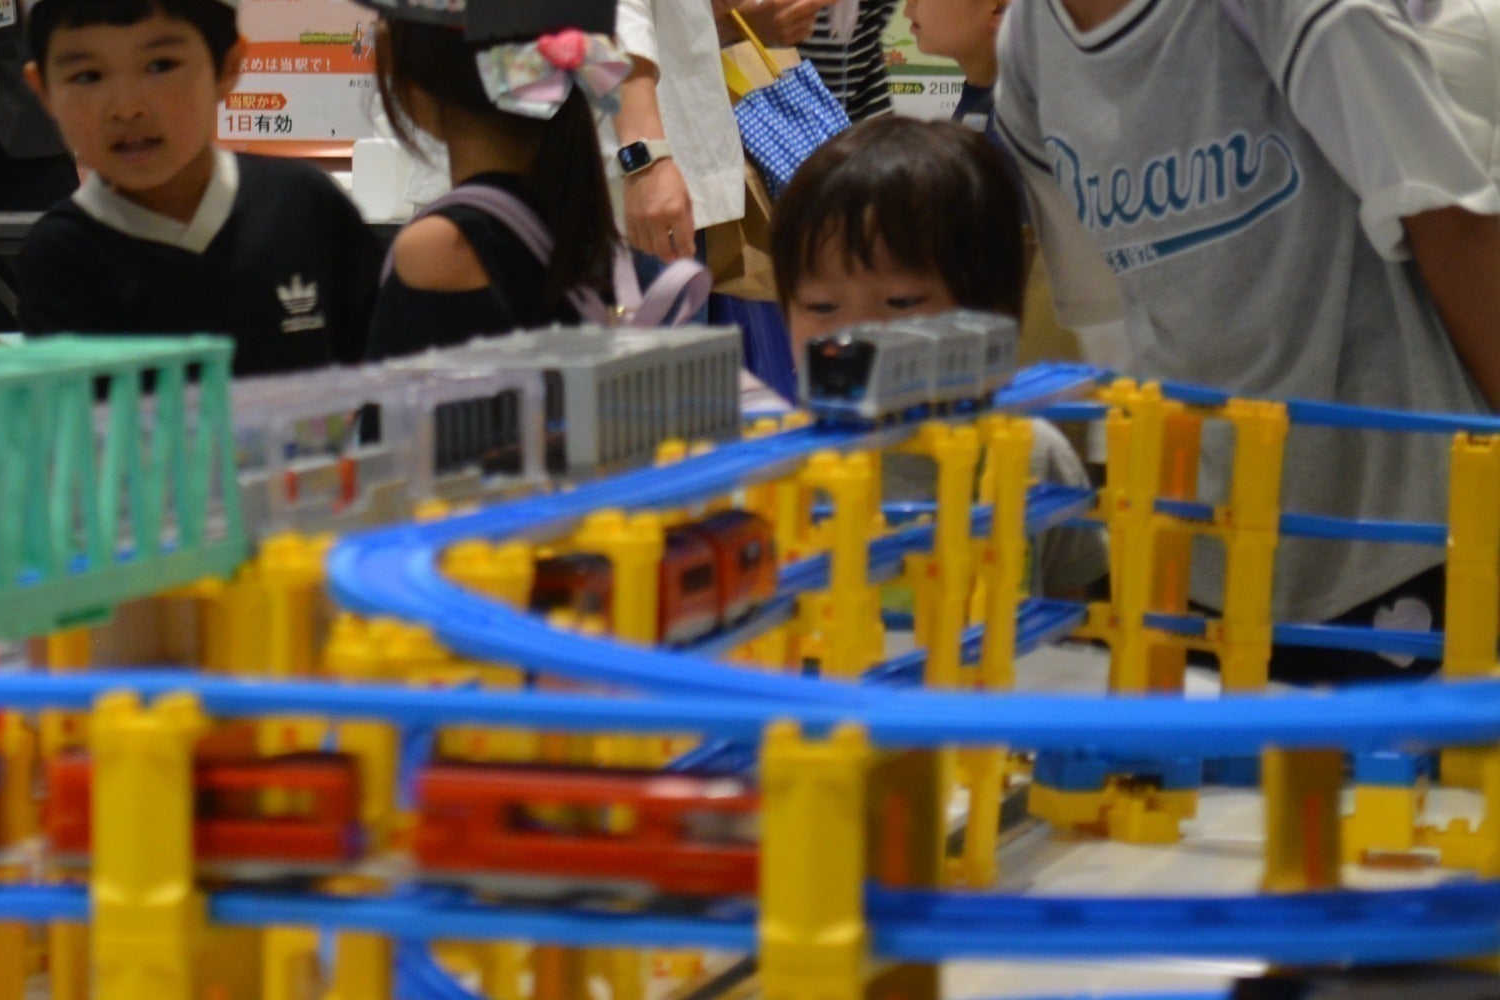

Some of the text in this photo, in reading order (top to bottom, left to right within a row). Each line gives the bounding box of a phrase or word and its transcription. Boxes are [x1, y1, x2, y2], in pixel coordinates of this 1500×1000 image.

[229, 95, 281, 109] 当駅から
[225, 114, 292, 133] 1日有効
[1046, 134, 1257, 231] Dream
